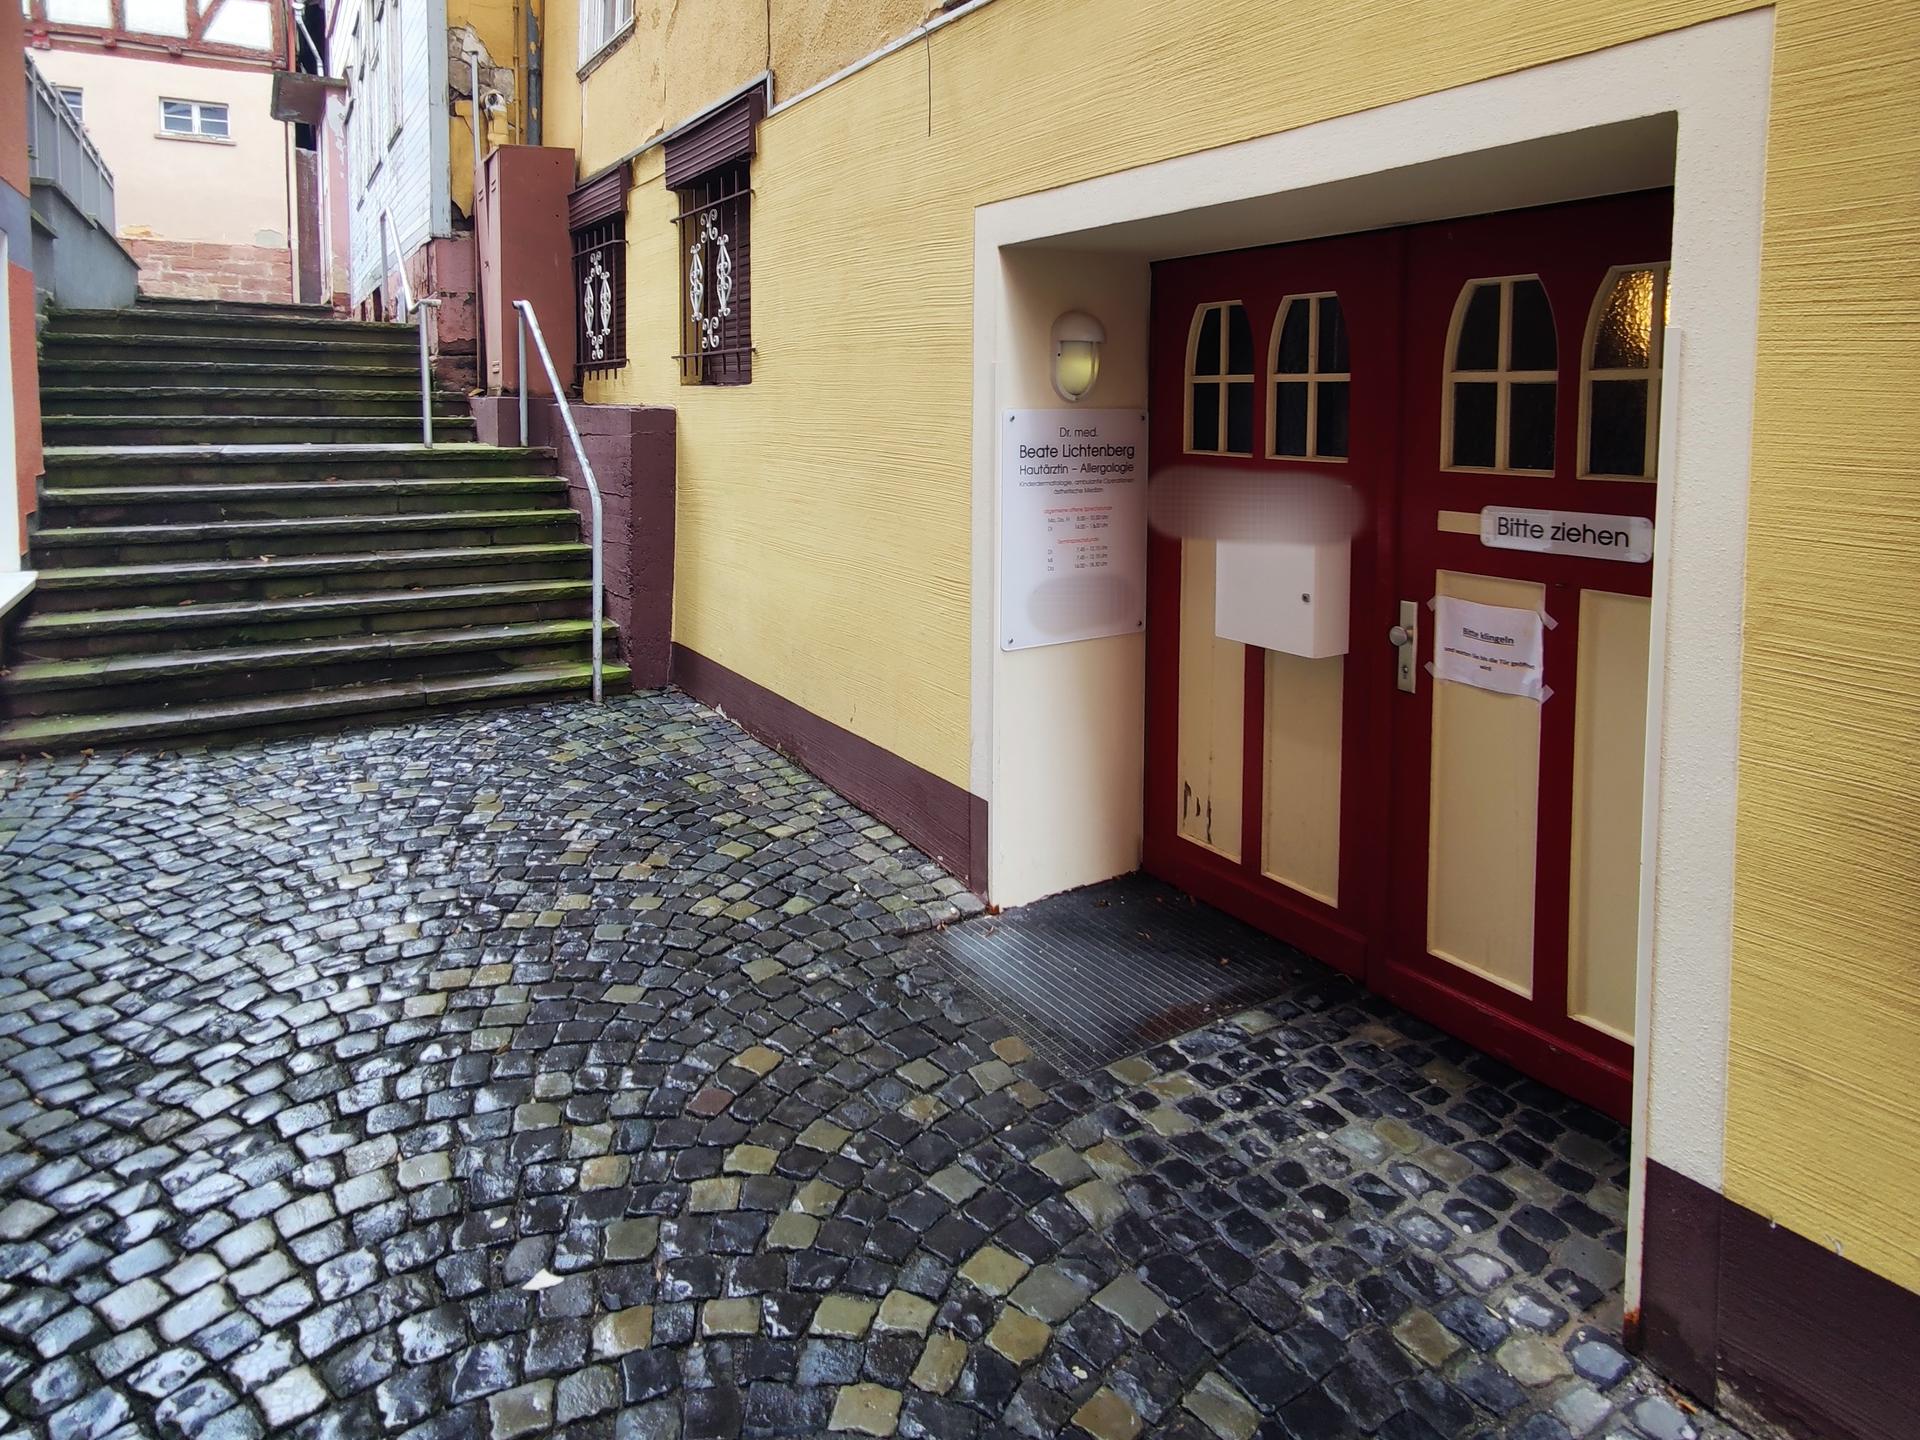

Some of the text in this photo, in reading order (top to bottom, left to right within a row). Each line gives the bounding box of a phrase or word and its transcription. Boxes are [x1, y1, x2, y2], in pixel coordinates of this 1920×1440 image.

[1059, 426, 1098, 438] Dr. med.
[1019, 443, 1136, 460] Beate Lichtenberg
[1019, 464, 1069, 475] Hautärztin
[1079, 462, 1135, 476] Allergologie
[1497, 516, 1630, 548] Bitte ziehen
[1463, 627, 1515, 646] Bitte klingeln
